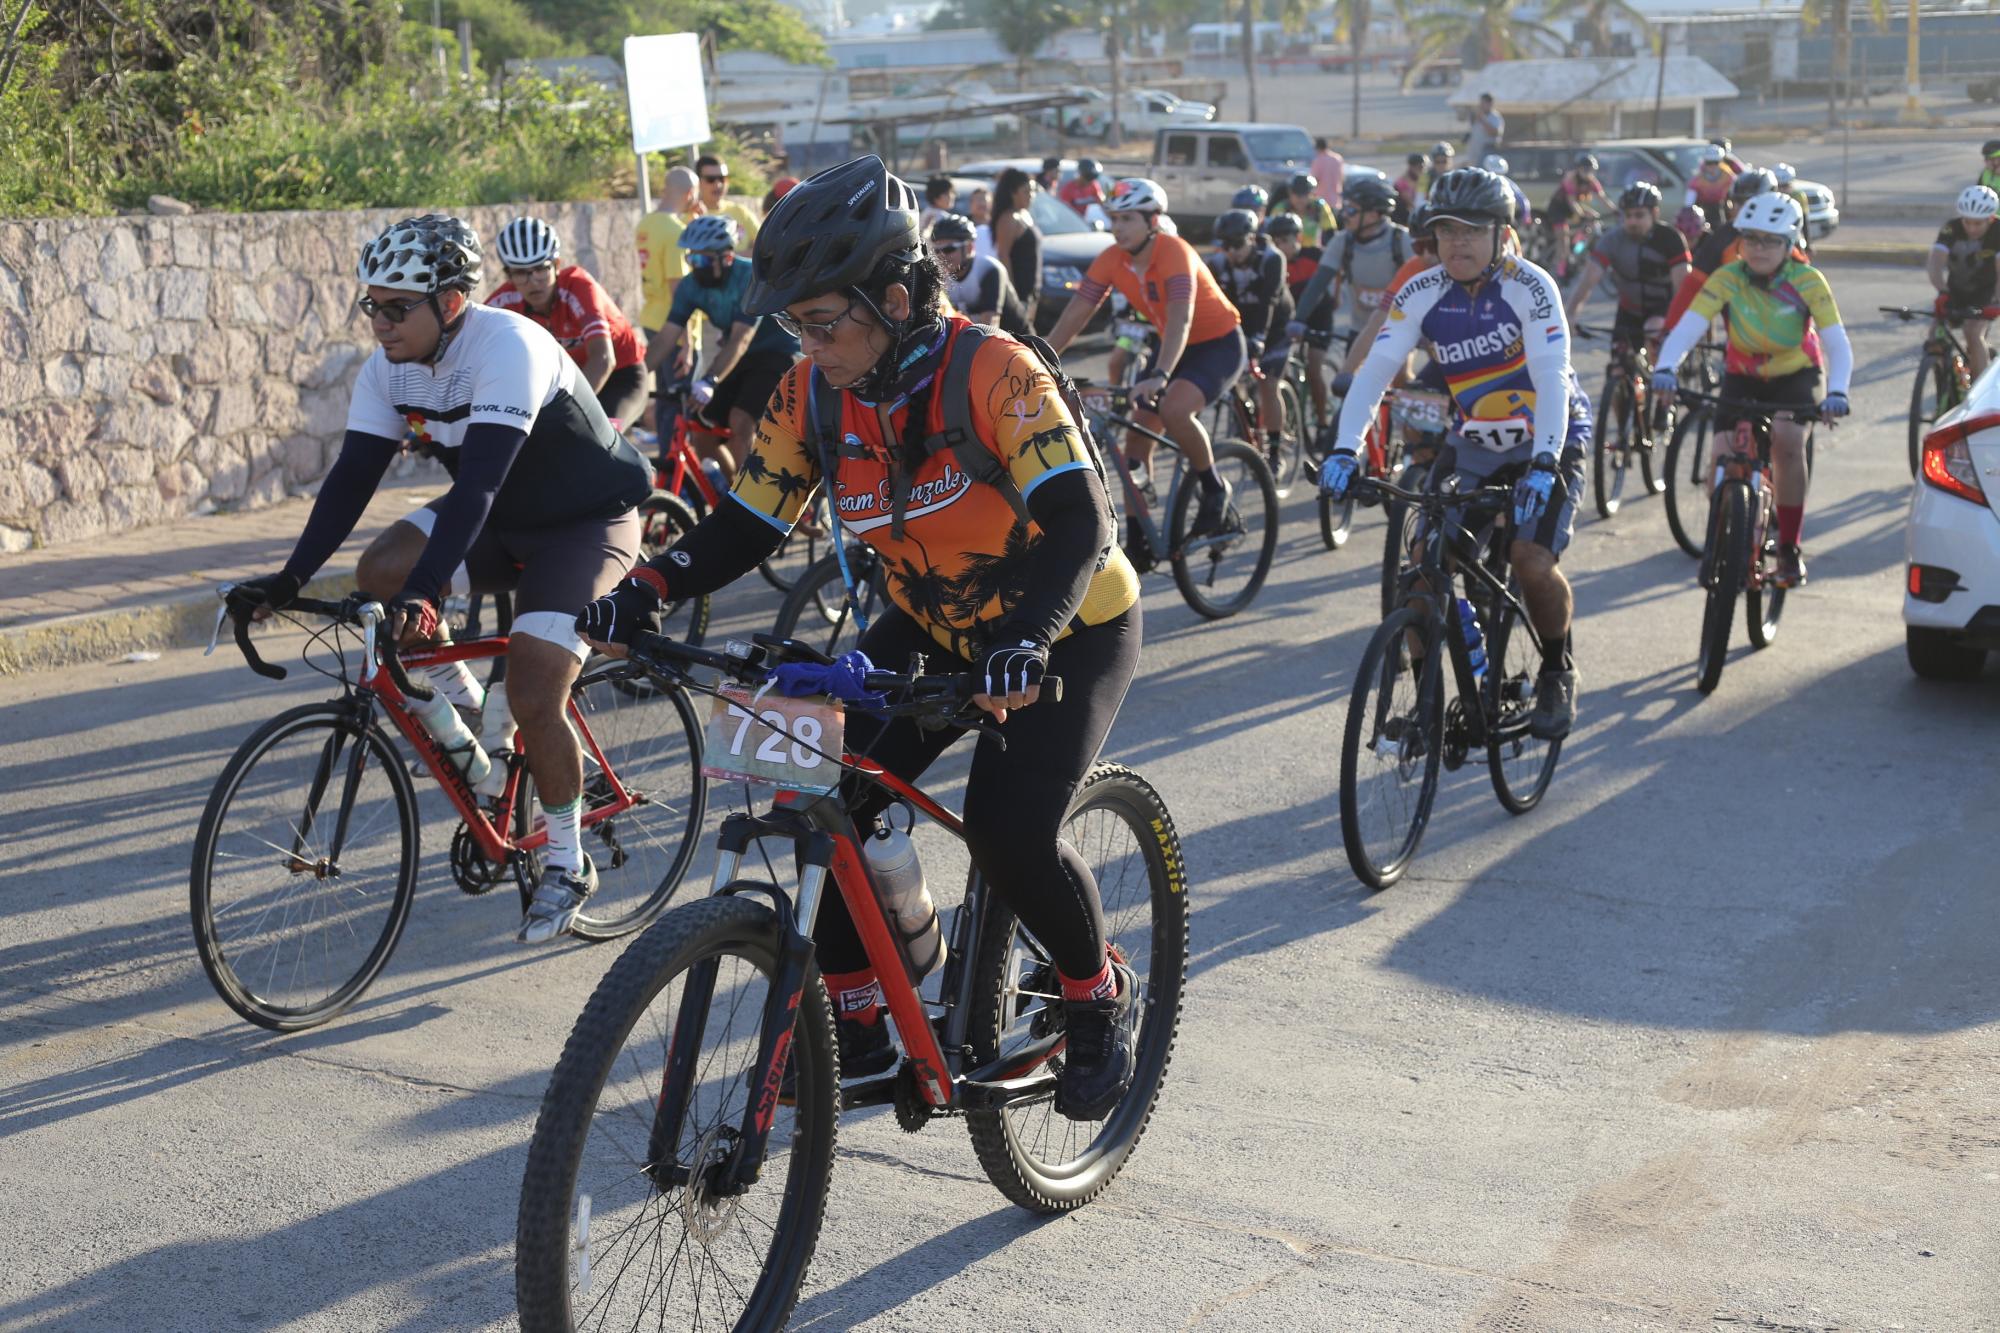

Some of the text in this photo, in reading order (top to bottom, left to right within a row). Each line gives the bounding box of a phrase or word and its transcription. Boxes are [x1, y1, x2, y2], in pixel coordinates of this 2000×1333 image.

[1434, 322, 1521, 365] banesto
[1464, 428, 1525, 446] 517
[727, 703, 823, 769] 728
[1150, 817, 1180, 894] MAXXIS
